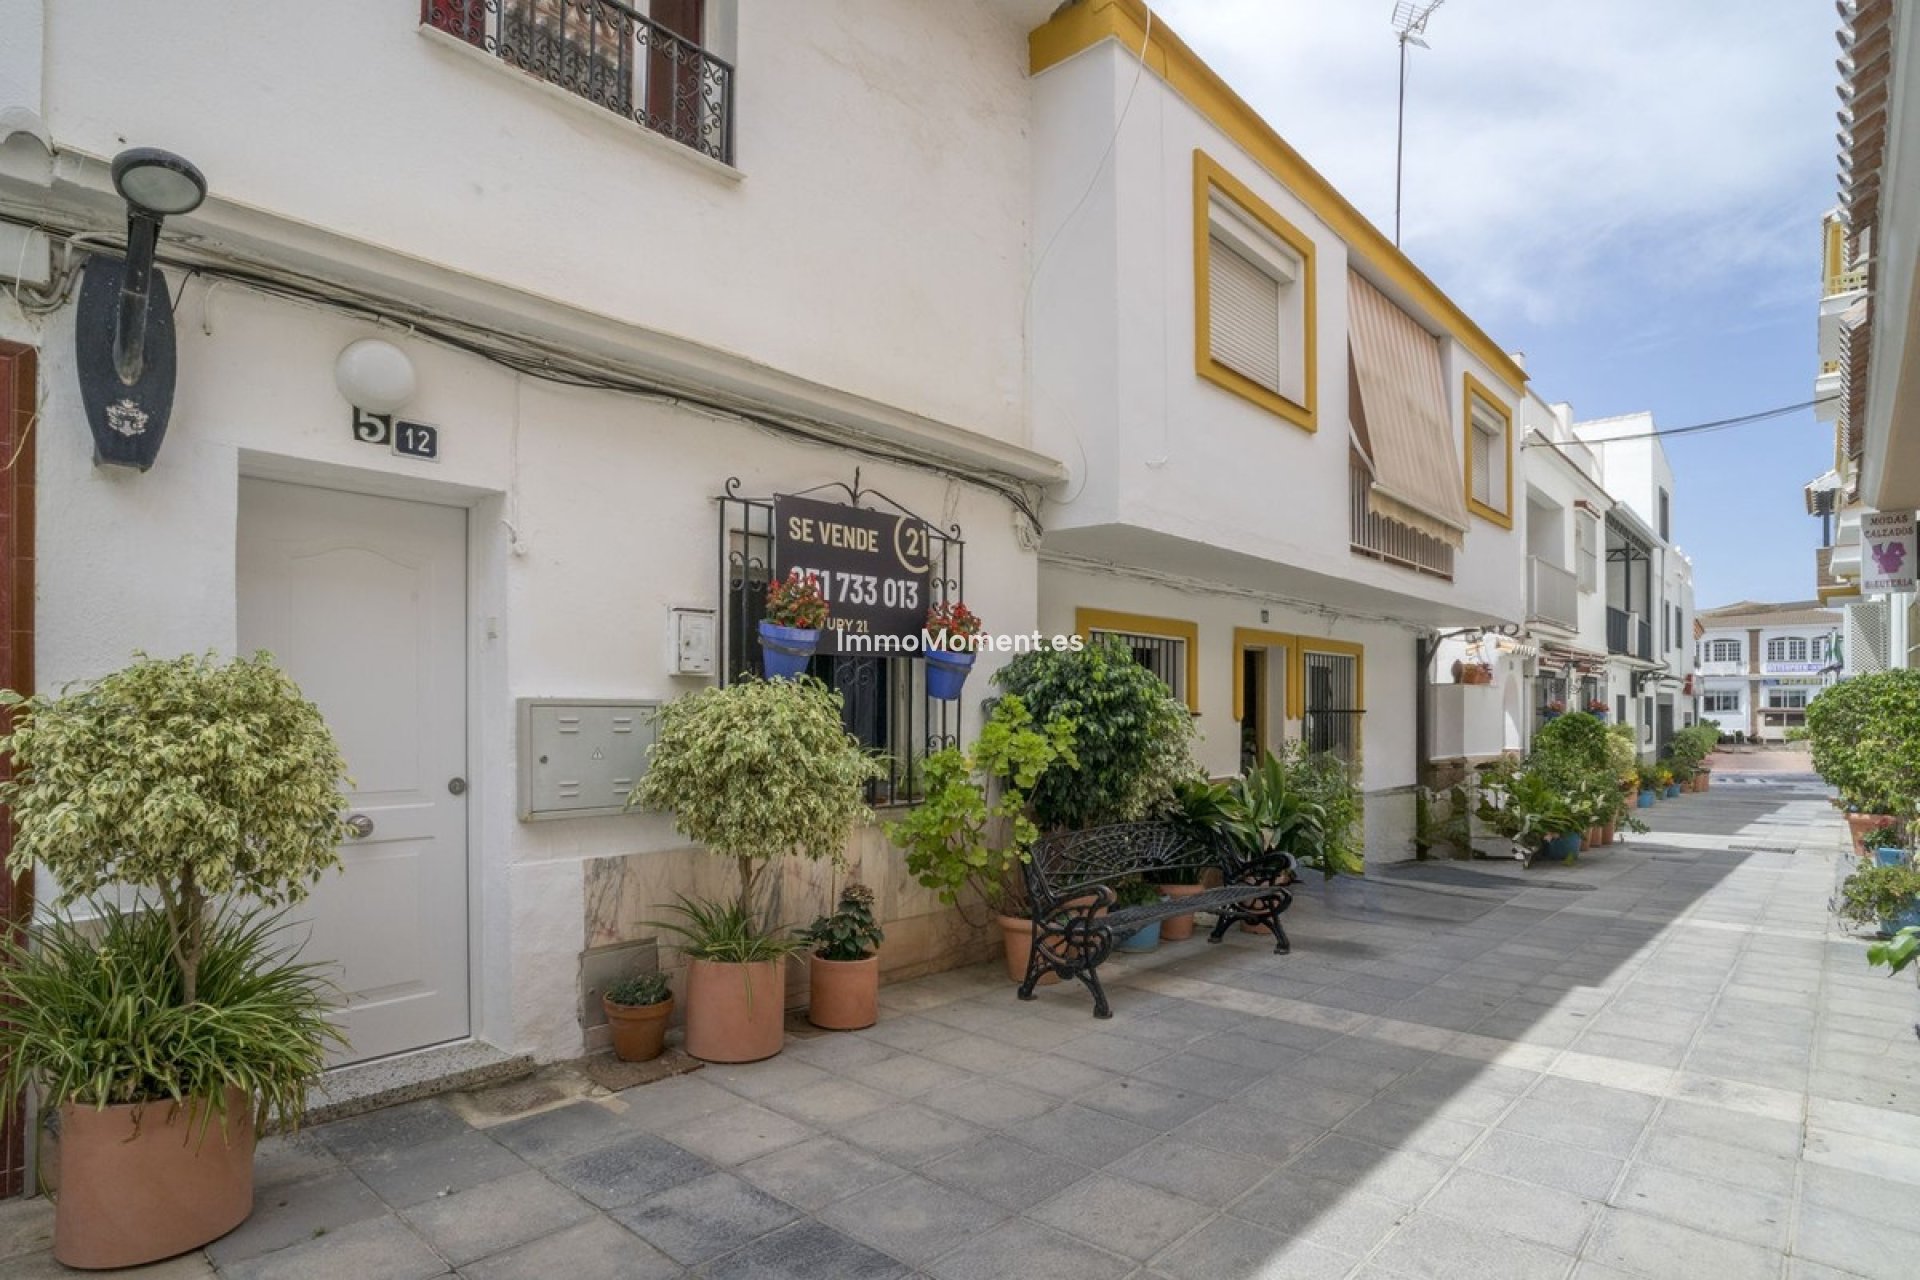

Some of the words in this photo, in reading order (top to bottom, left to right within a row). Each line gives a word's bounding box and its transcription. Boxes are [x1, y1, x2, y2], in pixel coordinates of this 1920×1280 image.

[359, 406, 386, 443] 5
[406, 428, 430, 453] 12
[788, 516, 814, 542] SE
[818, 521, 879, 552] VENDE
[1863, 526, 1914, 538] CALZADOS
[1870, 514, 1908, 526] MODAS
[836, 572, 878, 605] 733
[883, 578, 918, 609] 013
